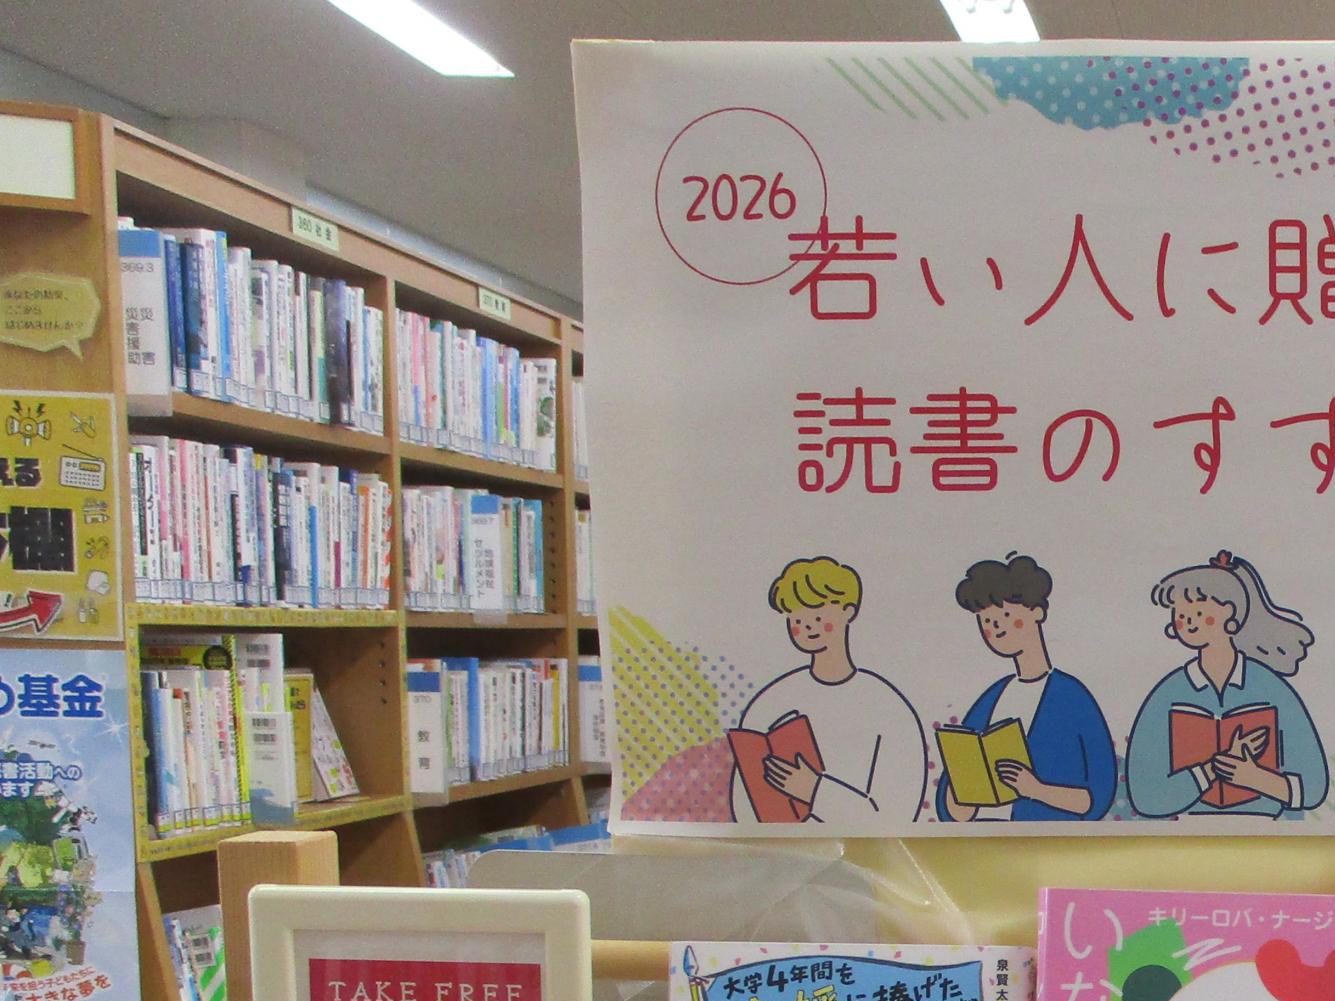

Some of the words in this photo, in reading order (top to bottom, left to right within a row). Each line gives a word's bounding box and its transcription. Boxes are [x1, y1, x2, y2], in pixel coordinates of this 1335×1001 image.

[682, 174, 797, 222] 2026
[0, 781, 34, 798] ます
[724, 960, 855, 999] 大学4年間を
